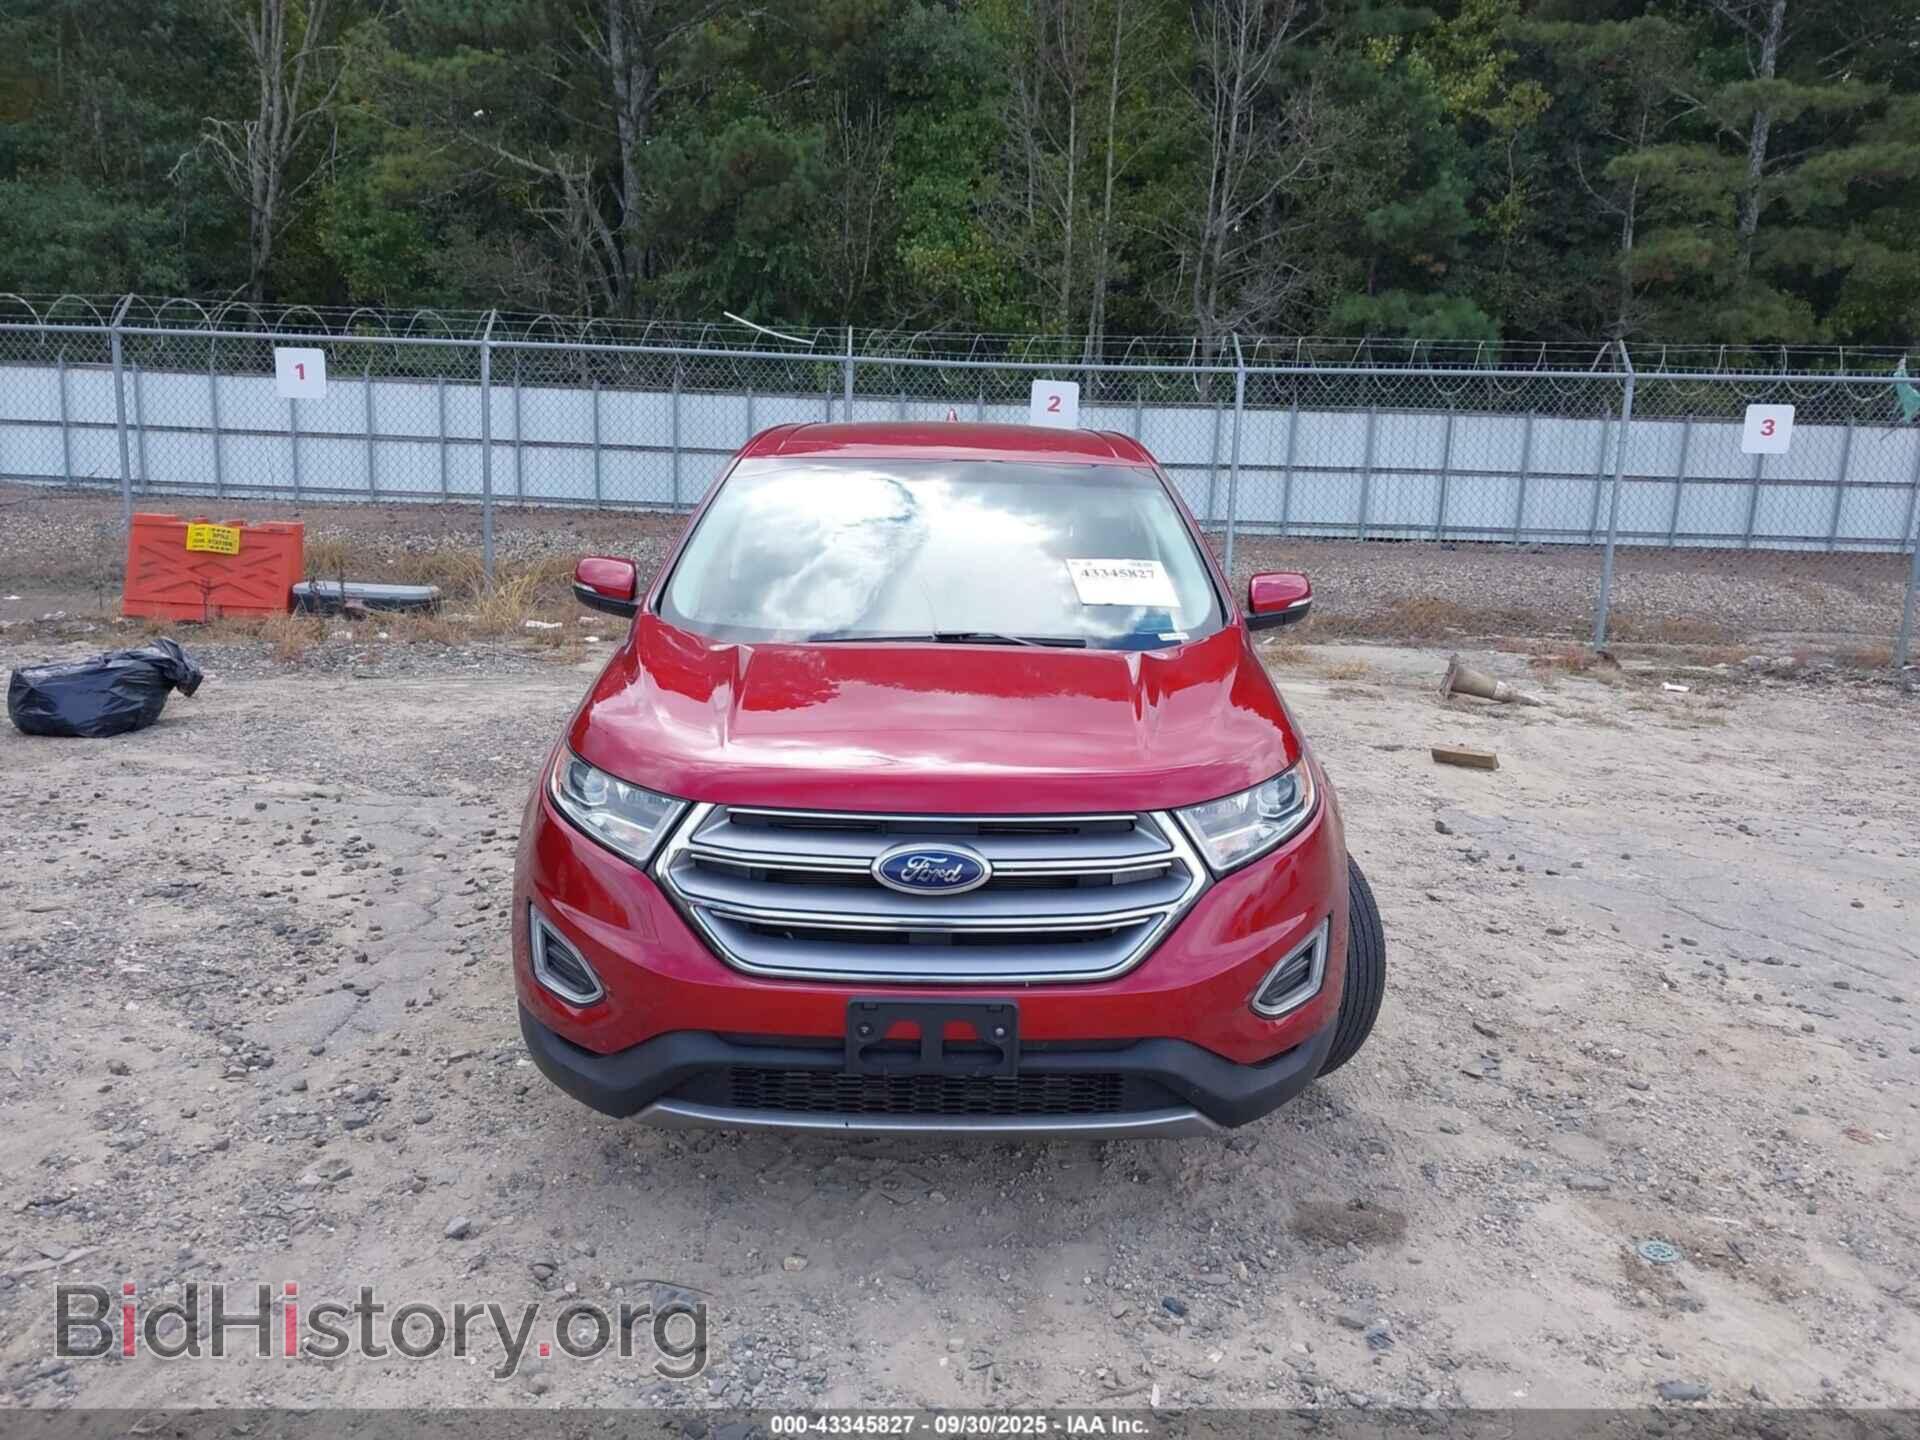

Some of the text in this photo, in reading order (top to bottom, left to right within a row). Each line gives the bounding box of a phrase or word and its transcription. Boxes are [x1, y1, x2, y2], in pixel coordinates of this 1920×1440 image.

[295, 363, 305, 380] 1
[1047, 395, 1061, 413] 2
[1760, 418, 1775, 436] 3
[1080, 568, 1154, 579] 43345827
[900, 855, 963, 882] Ford
